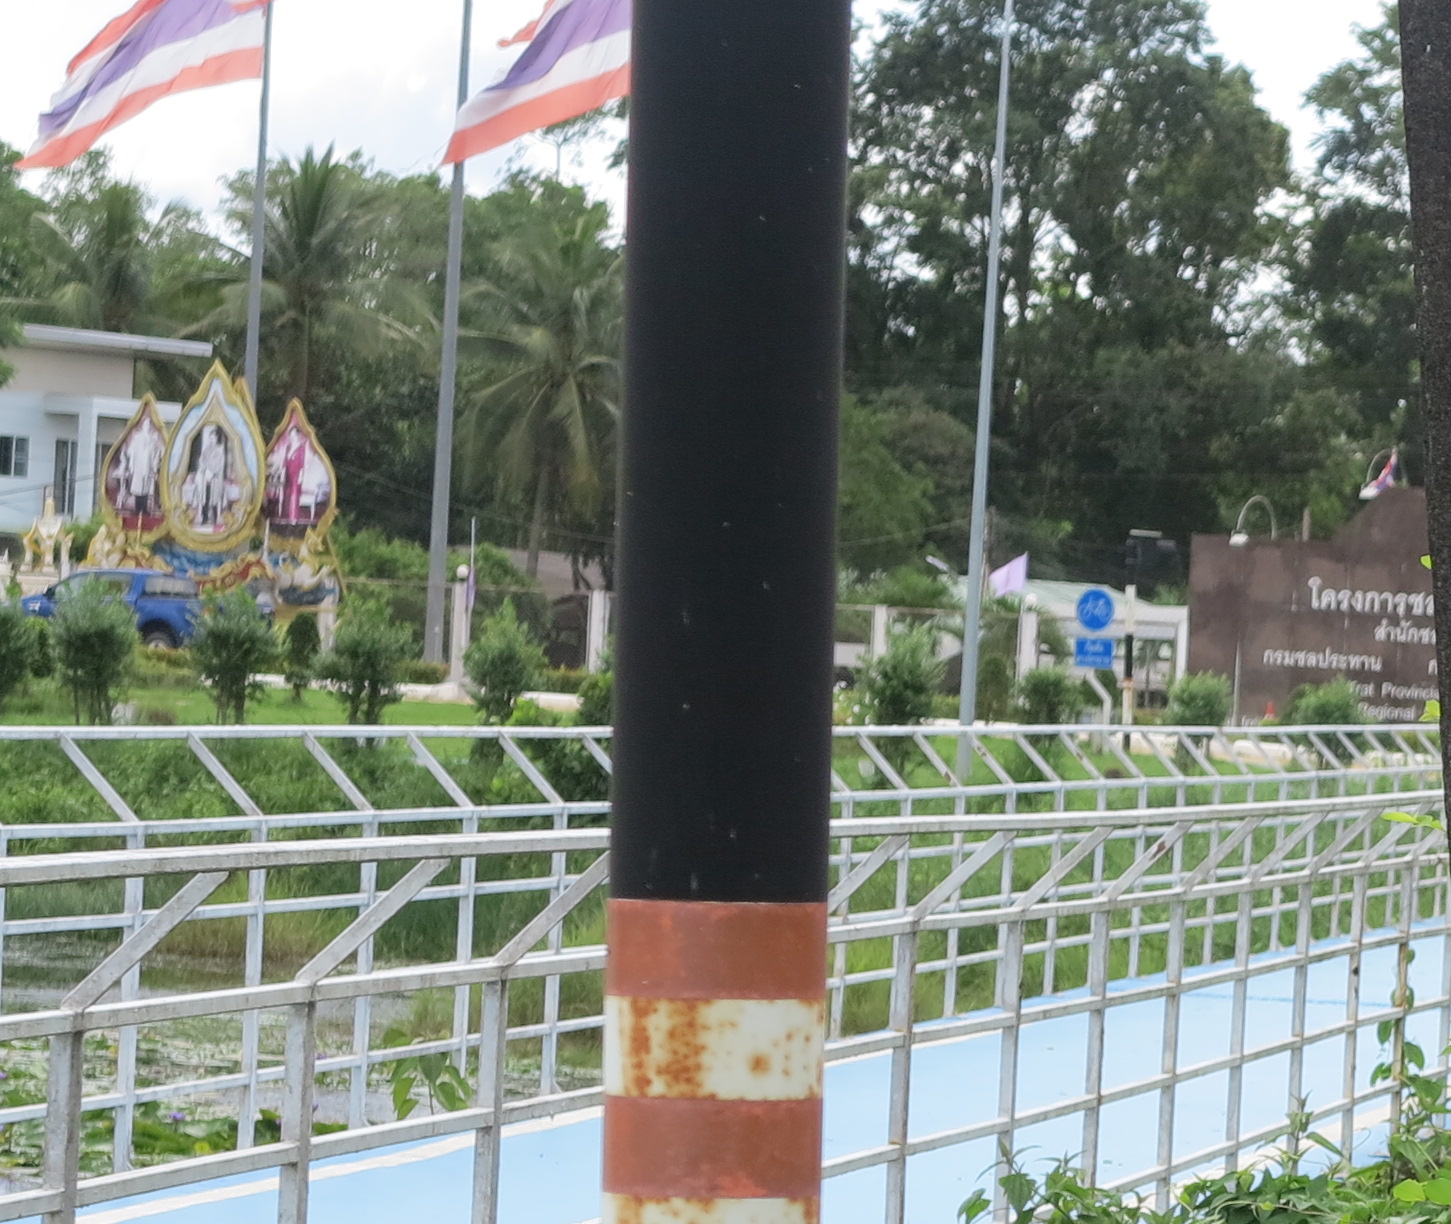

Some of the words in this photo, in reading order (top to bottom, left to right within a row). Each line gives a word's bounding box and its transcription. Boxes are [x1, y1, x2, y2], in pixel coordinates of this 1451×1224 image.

[1263, 647, 1382, 673] กรมชลประทาน
